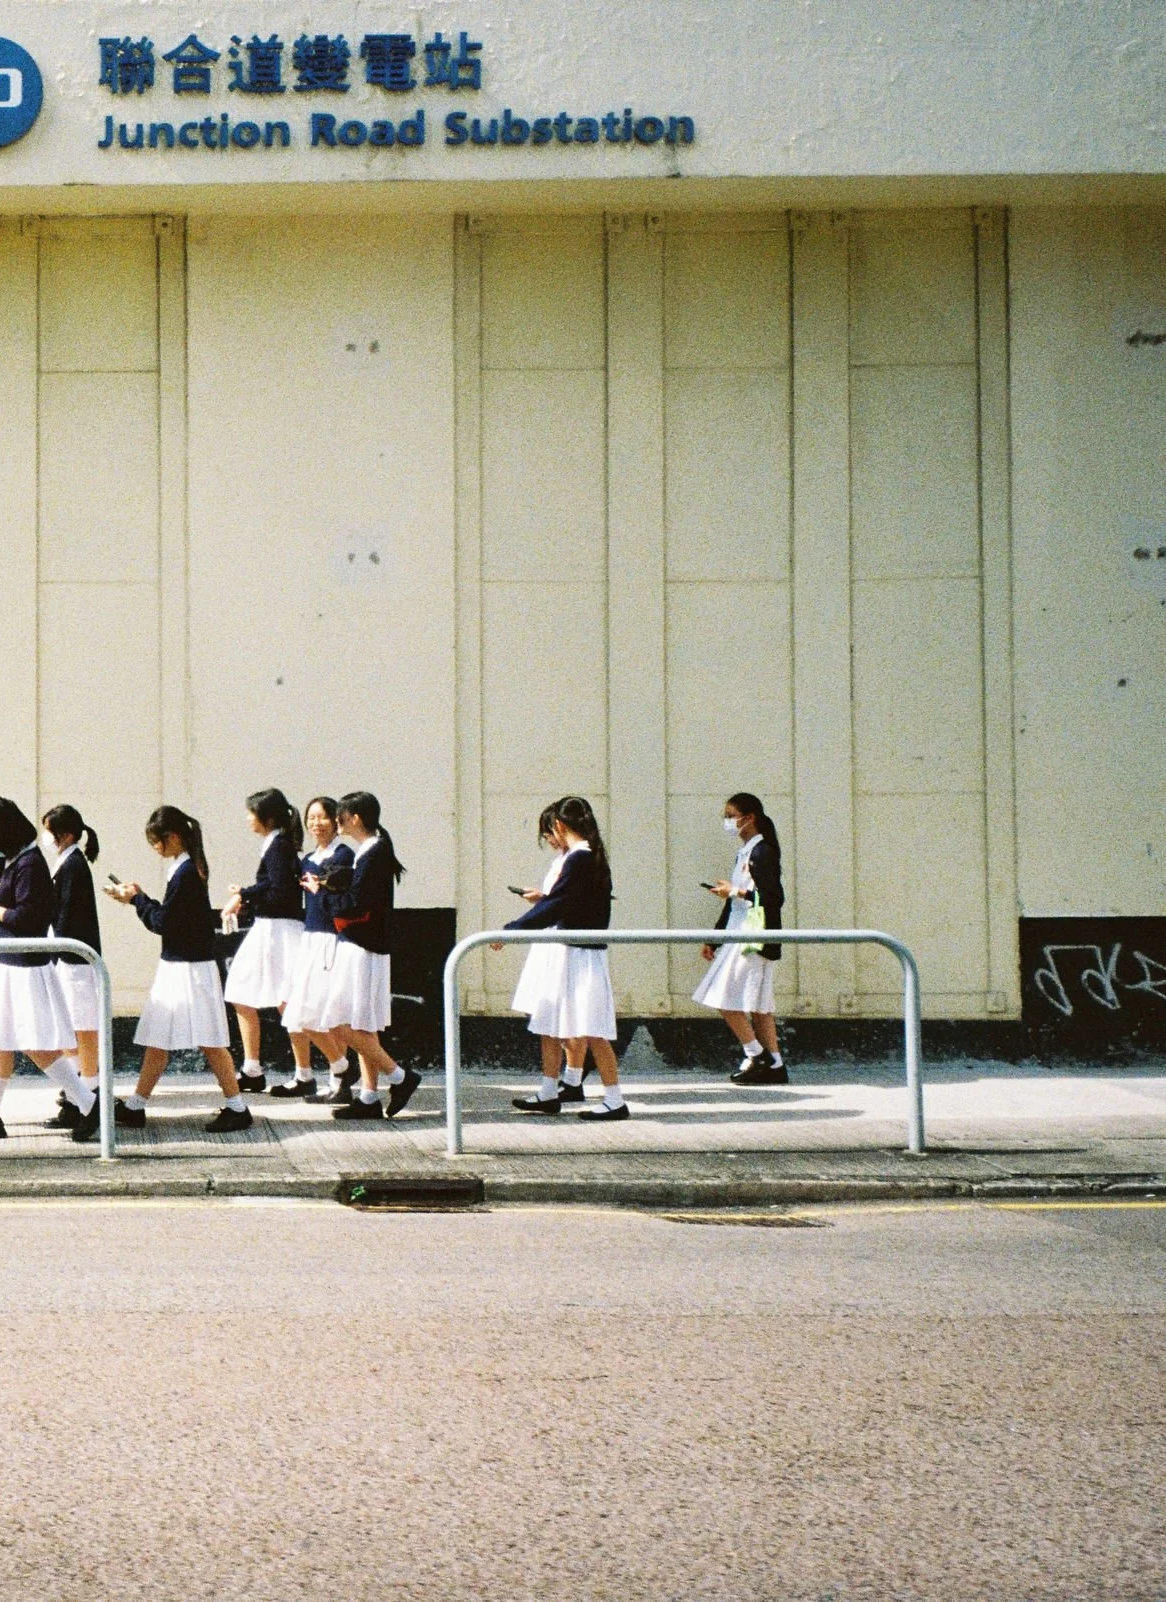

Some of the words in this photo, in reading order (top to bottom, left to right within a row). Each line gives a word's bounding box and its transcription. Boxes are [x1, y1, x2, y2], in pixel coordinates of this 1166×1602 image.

[99, 32, 483, 94] 聯合道變電站
[98, 112, 291, 149] Junction
[311, 108, 426, 146] Road
[445, 108, 696, 146] Substation
